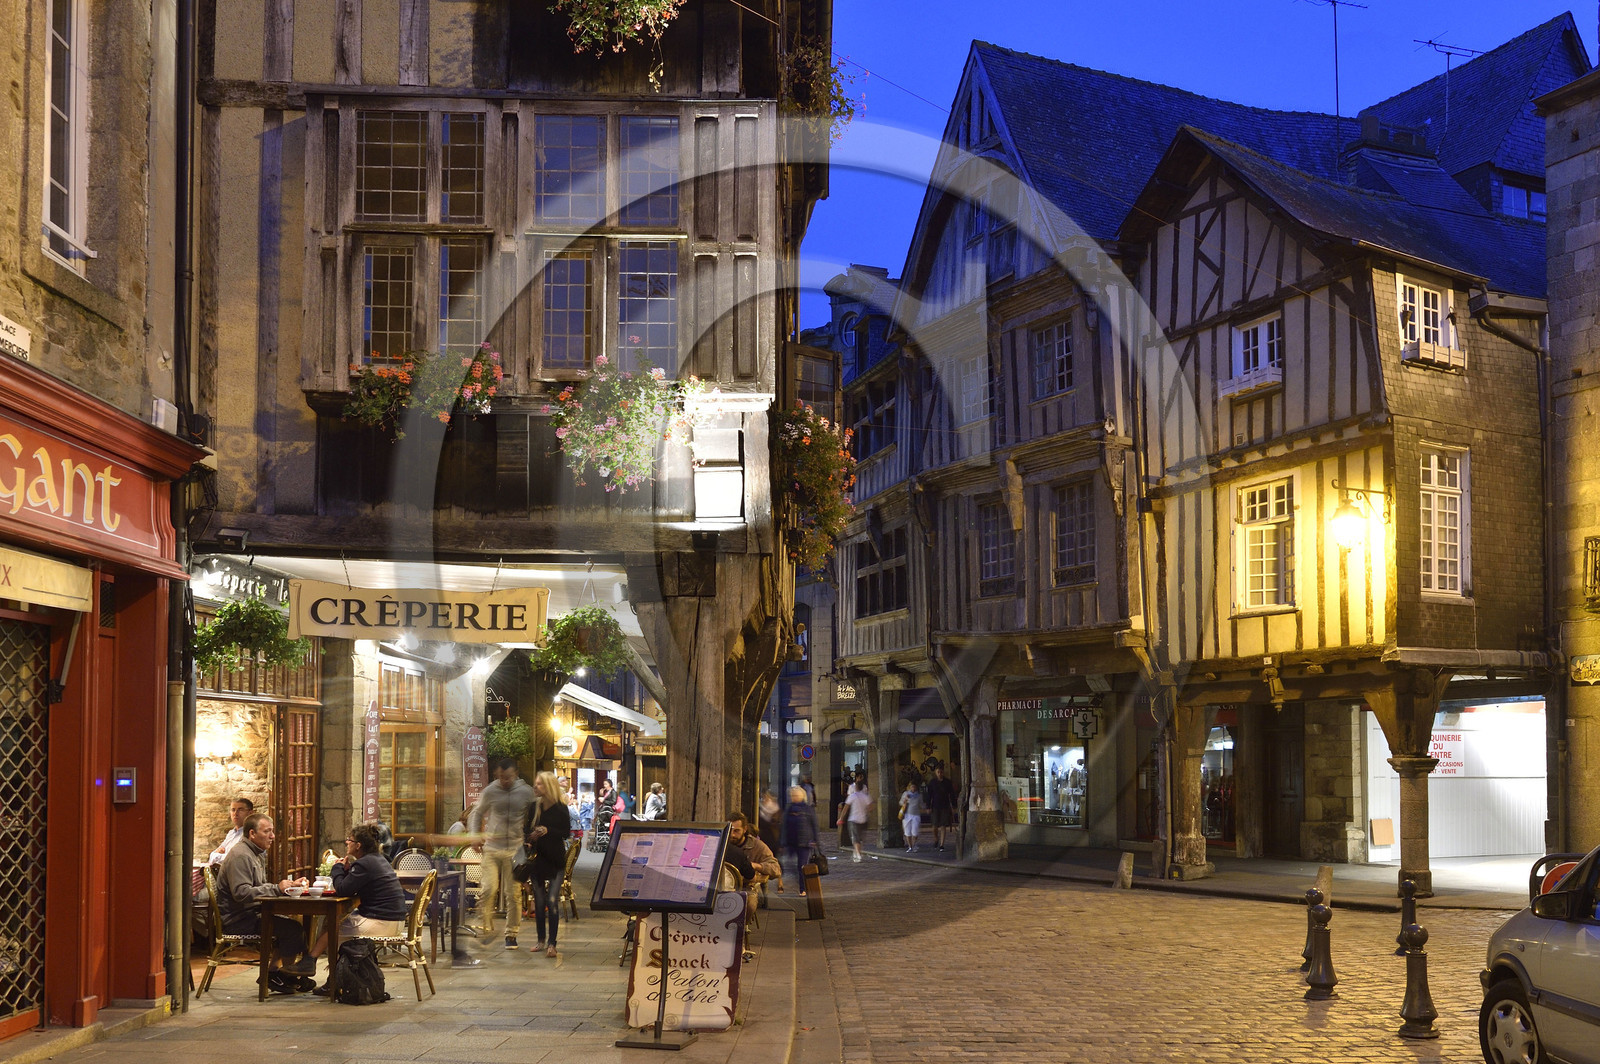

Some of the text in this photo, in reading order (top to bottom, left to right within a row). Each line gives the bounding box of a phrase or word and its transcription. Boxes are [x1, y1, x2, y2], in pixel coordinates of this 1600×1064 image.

[0, 320, 16, 336] LACE
[310, 594, 528, 631] CRÊPERIE
[997, 699, 1042, 711] PHARMACIE
[1037, 707, 1075, 719] DESARCA
[1431, 734, 1462, 742] QUINERIE
[467, 744, 484, 752] LAIT
[1427, 751, 1452, 759] ENTRE
